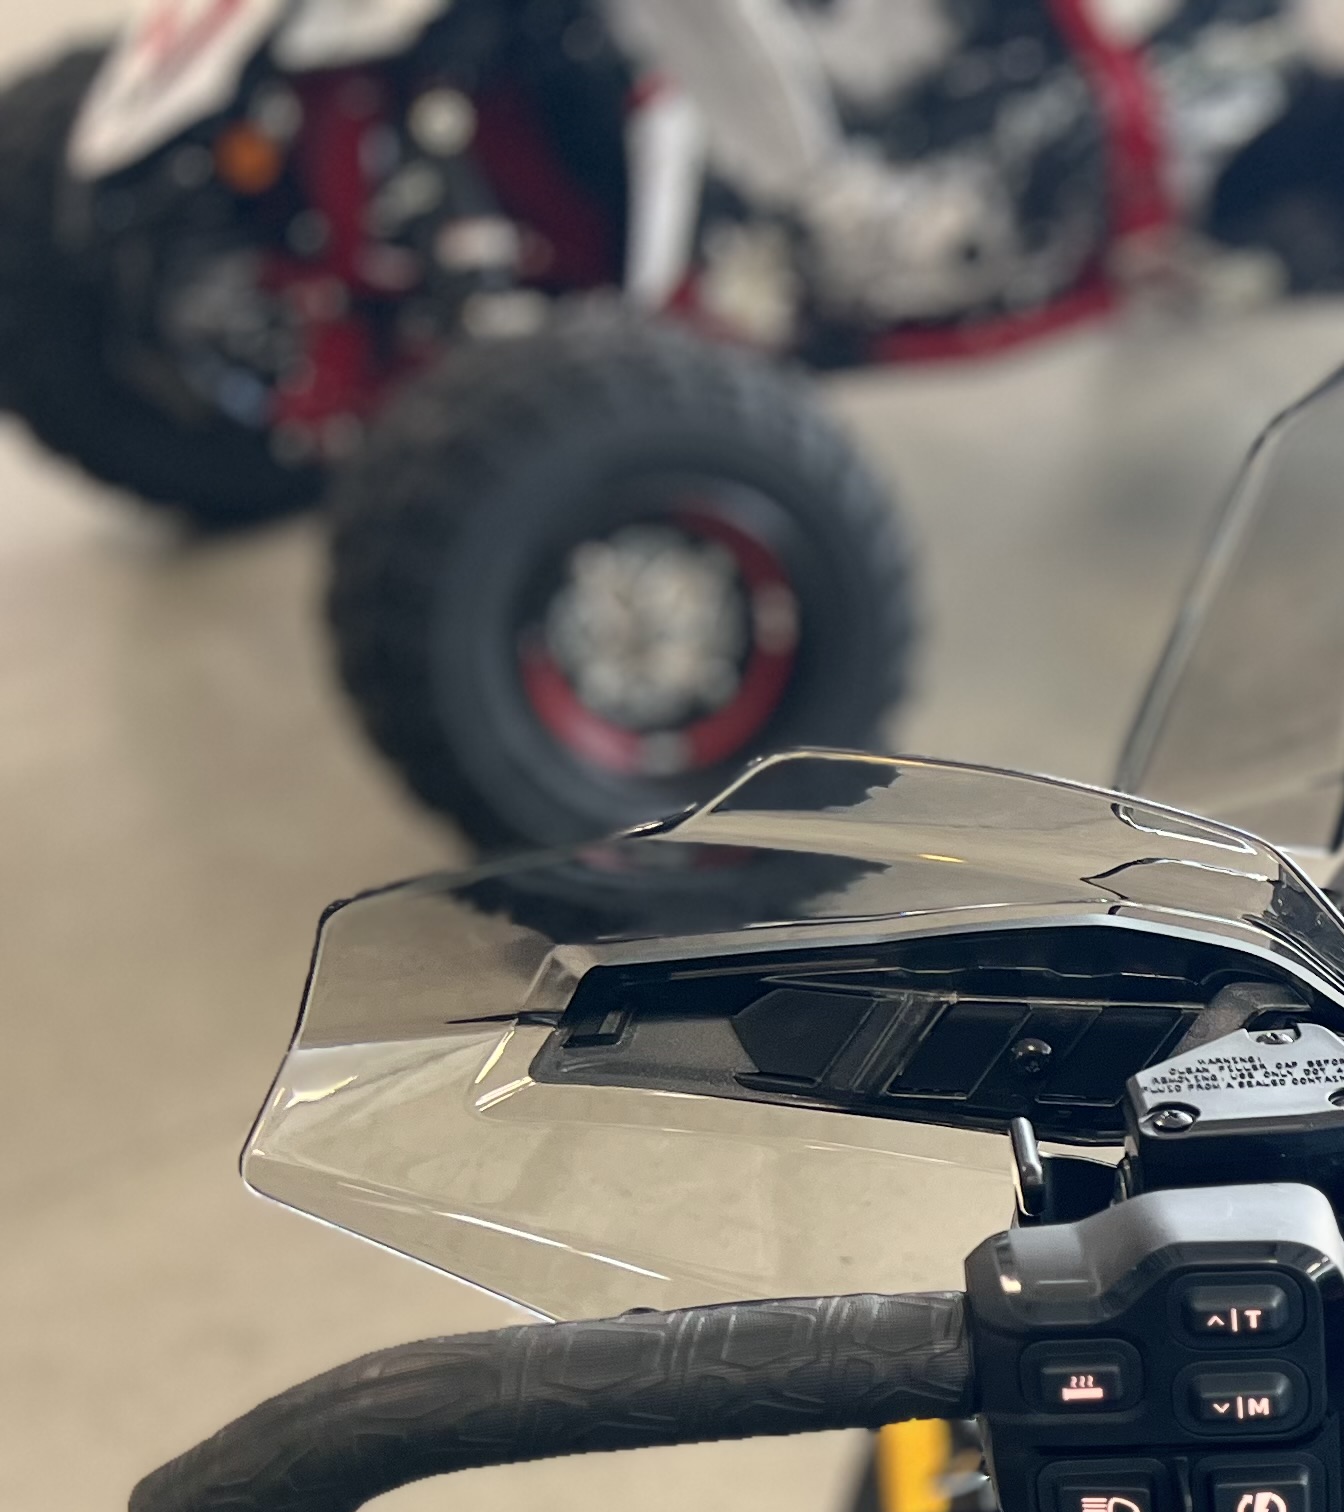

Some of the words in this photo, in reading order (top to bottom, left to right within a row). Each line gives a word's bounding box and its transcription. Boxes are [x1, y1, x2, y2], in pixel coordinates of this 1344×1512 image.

[1169, 1067, 1210, 1075] CLEAN
[1219, 1063, 1267, 1072] FILLER
[1275, 1061, 1298, 1069] CAP
[1230, 1071, 1255, 1080] USE
[1263, 1069, 1293, 1078] ONLY
[1303, 1067, 1326, 1076] DOT
[1187, 1083, 1221, 1091] FROM
[1238, 1079, 1286, 1088] SEALED
[1244, 1309, 1262, 1329] T
[1247, 1397, 1270, 1416] M
